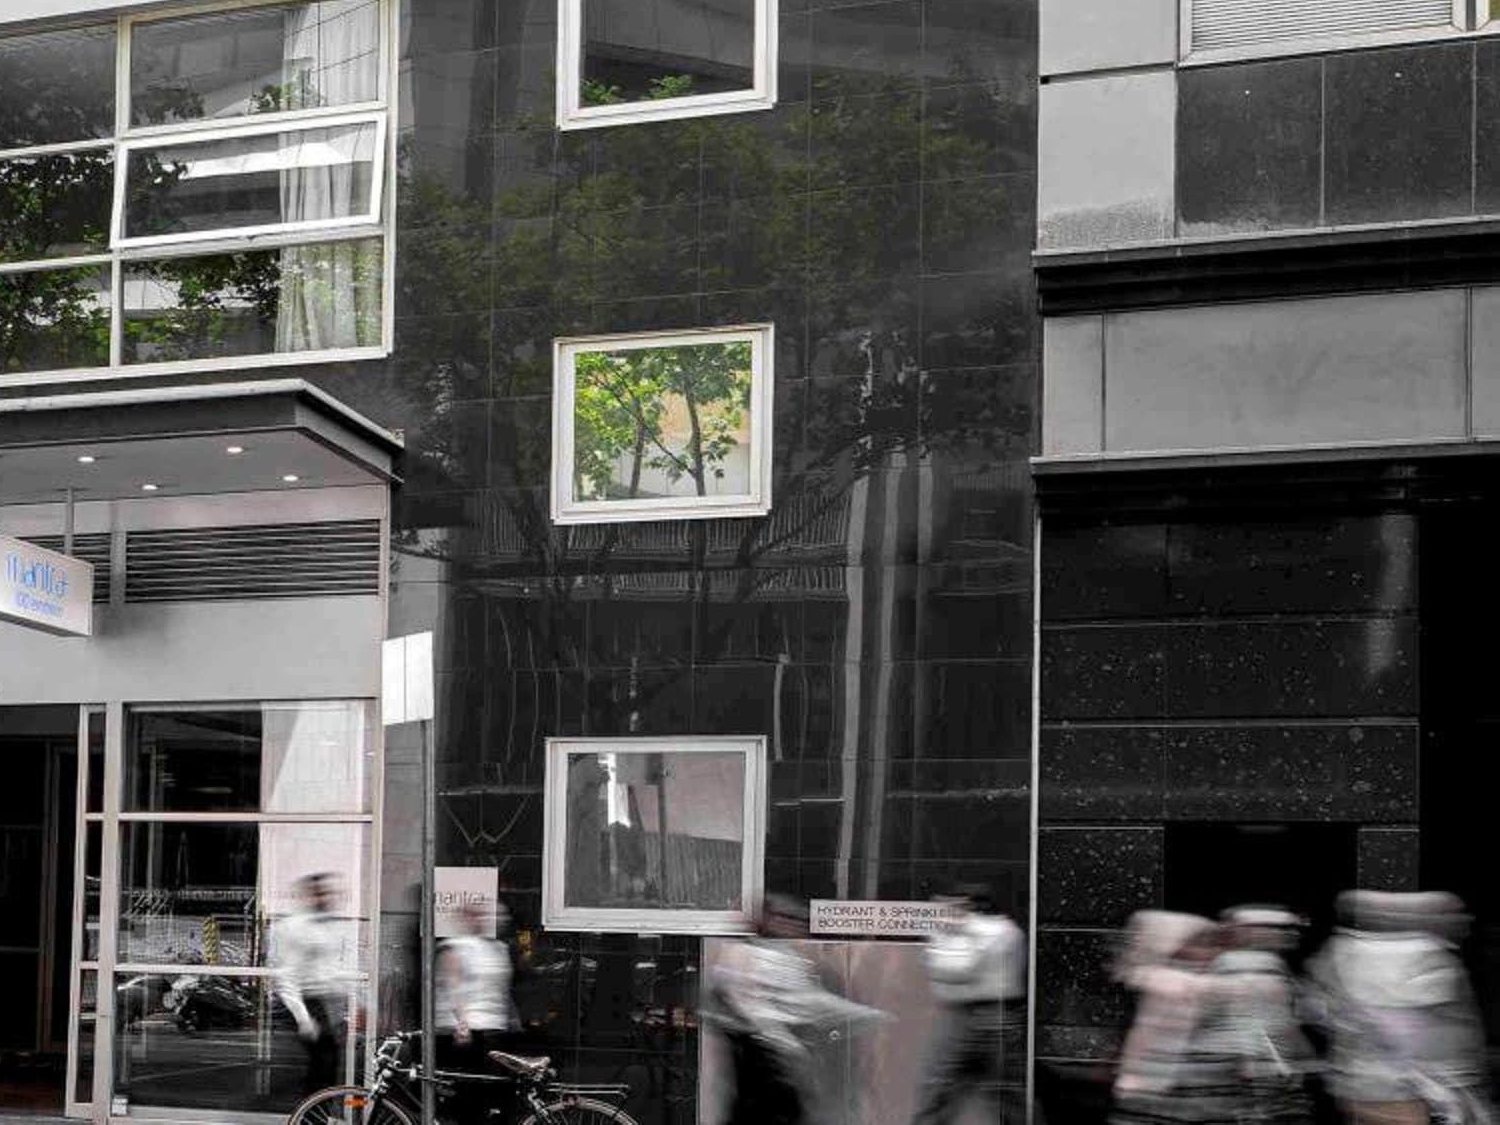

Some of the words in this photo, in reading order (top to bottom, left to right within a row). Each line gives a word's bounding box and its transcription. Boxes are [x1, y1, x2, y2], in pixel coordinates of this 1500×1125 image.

[817, 906, 874, 918] HYDRANT
[878, 906, 887, 917] &
[819, 918, 875, 931] BOOSTER
